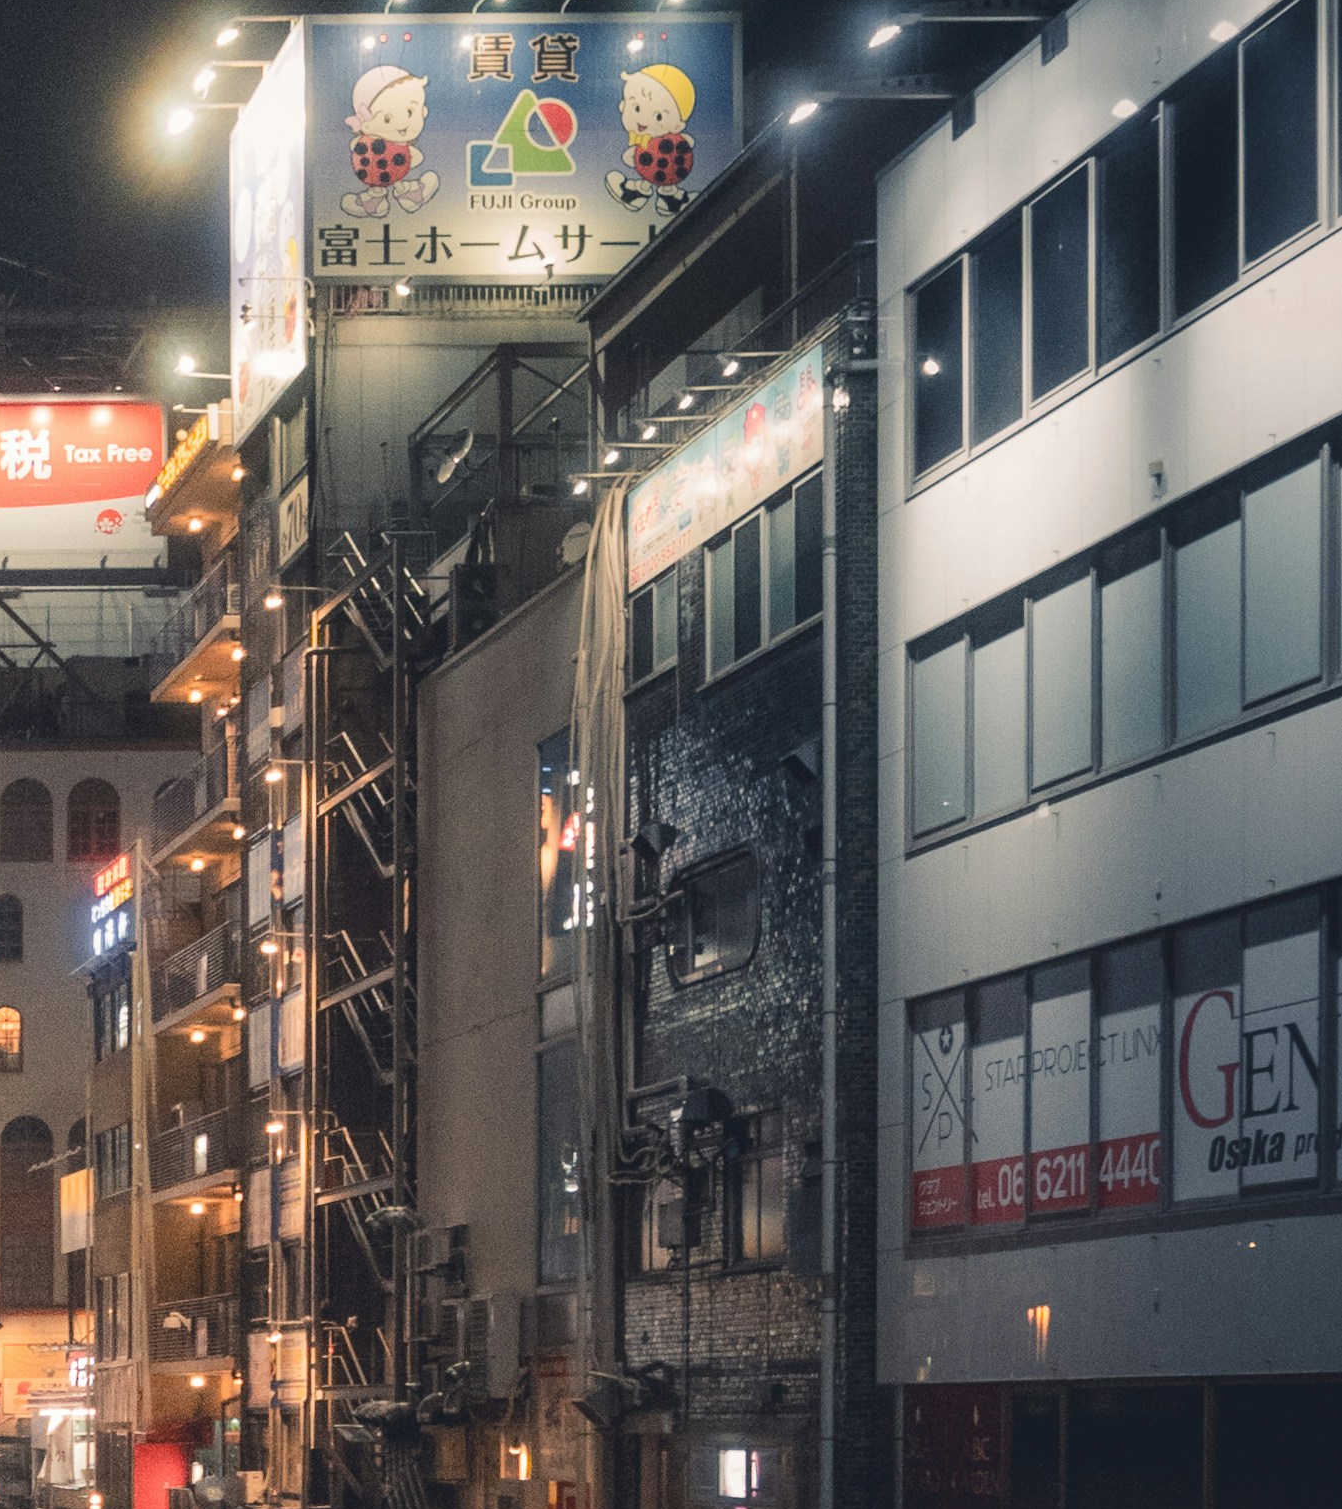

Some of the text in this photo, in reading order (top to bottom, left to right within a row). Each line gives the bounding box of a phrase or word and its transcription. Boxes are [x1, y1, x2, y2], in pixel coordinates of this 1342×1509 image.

[468, 32, 580, 83] 賃貸
[470, 193, 577, 211] FUJI Group
[317, 222, 657, 268] 富士ホームサー
[64, 443, 102, 464] Tax
[106, 443, 153, 464] Free
[1209, 1129, 1286, 1173] Osaka
[998, 1162, 1026, 1208] 06
[1036, 1151, 1086, 1201] 6211
